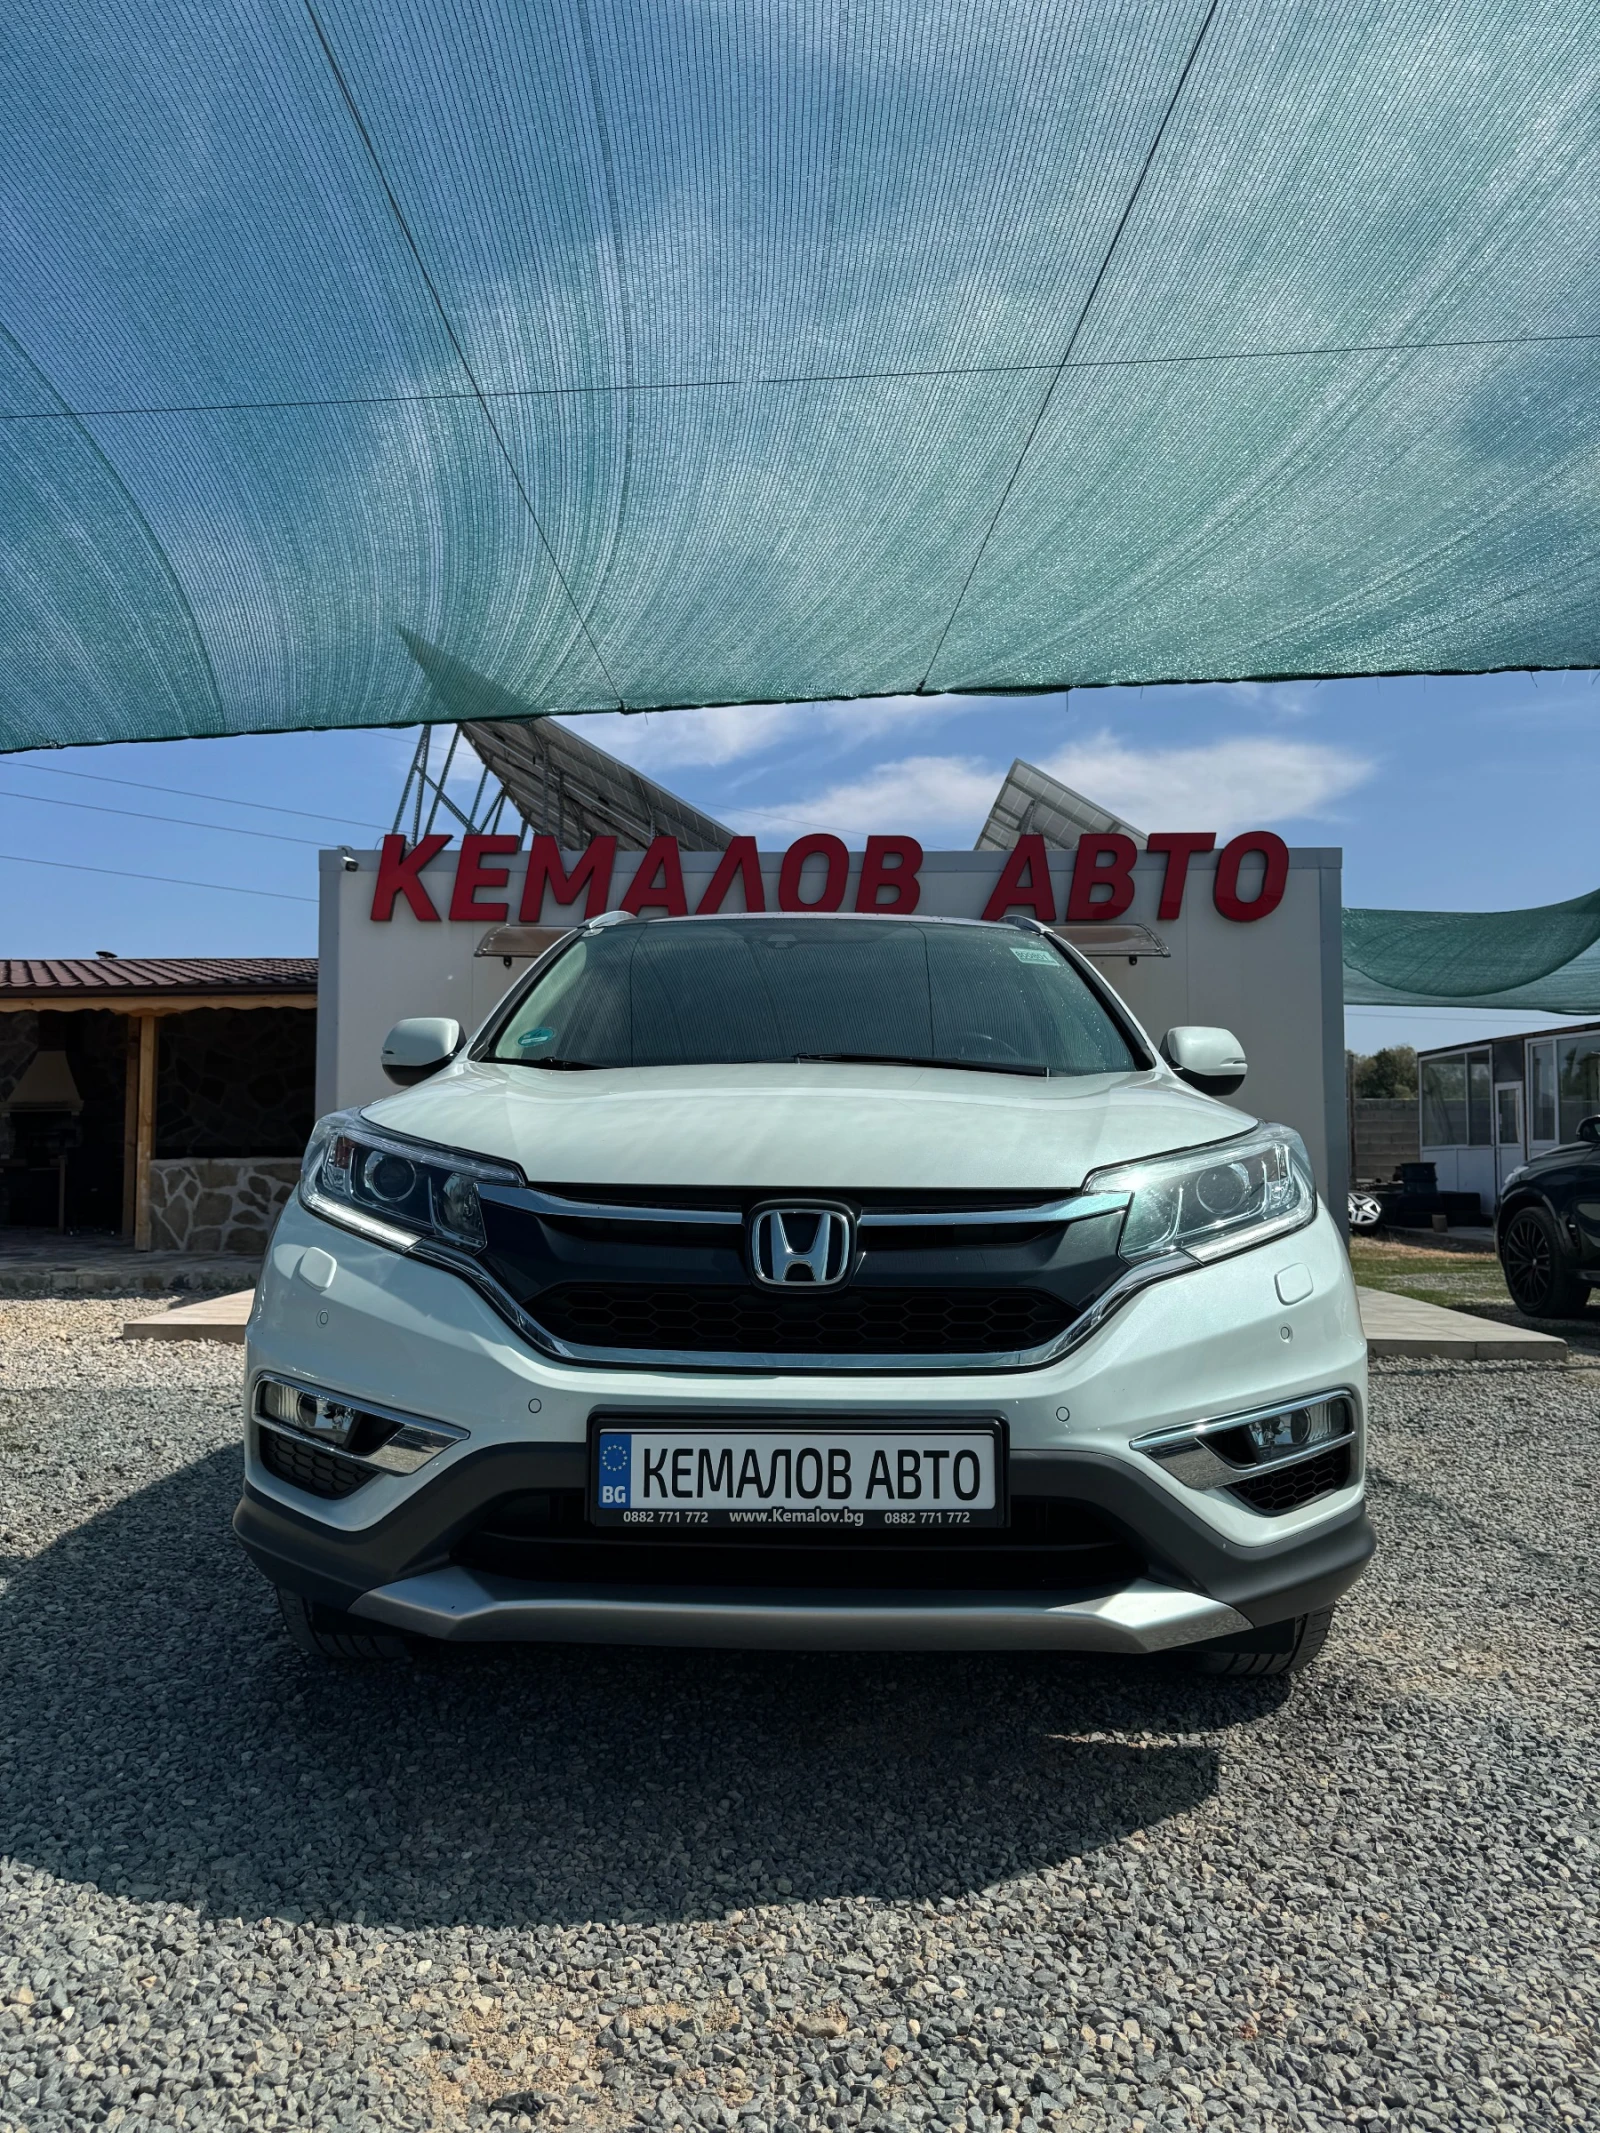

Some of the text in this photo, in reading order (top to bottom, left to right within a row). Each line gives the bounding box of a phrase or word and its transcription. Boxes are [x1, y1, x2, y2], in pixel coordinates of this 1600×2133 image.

[371, 831, 1289, 922] КЕМАЛОВ АВТО
[643, 1448, 981, 1502] КЕМАЛОВ АВТО
[602, 1485, 626, 1504] BG
[623, 1511, 709, 1524] 0882 771 772
[729, 1508, 864, 1527] www.Kemalov.bg
[884, 1512, 971, 1524] 0882 771 772
